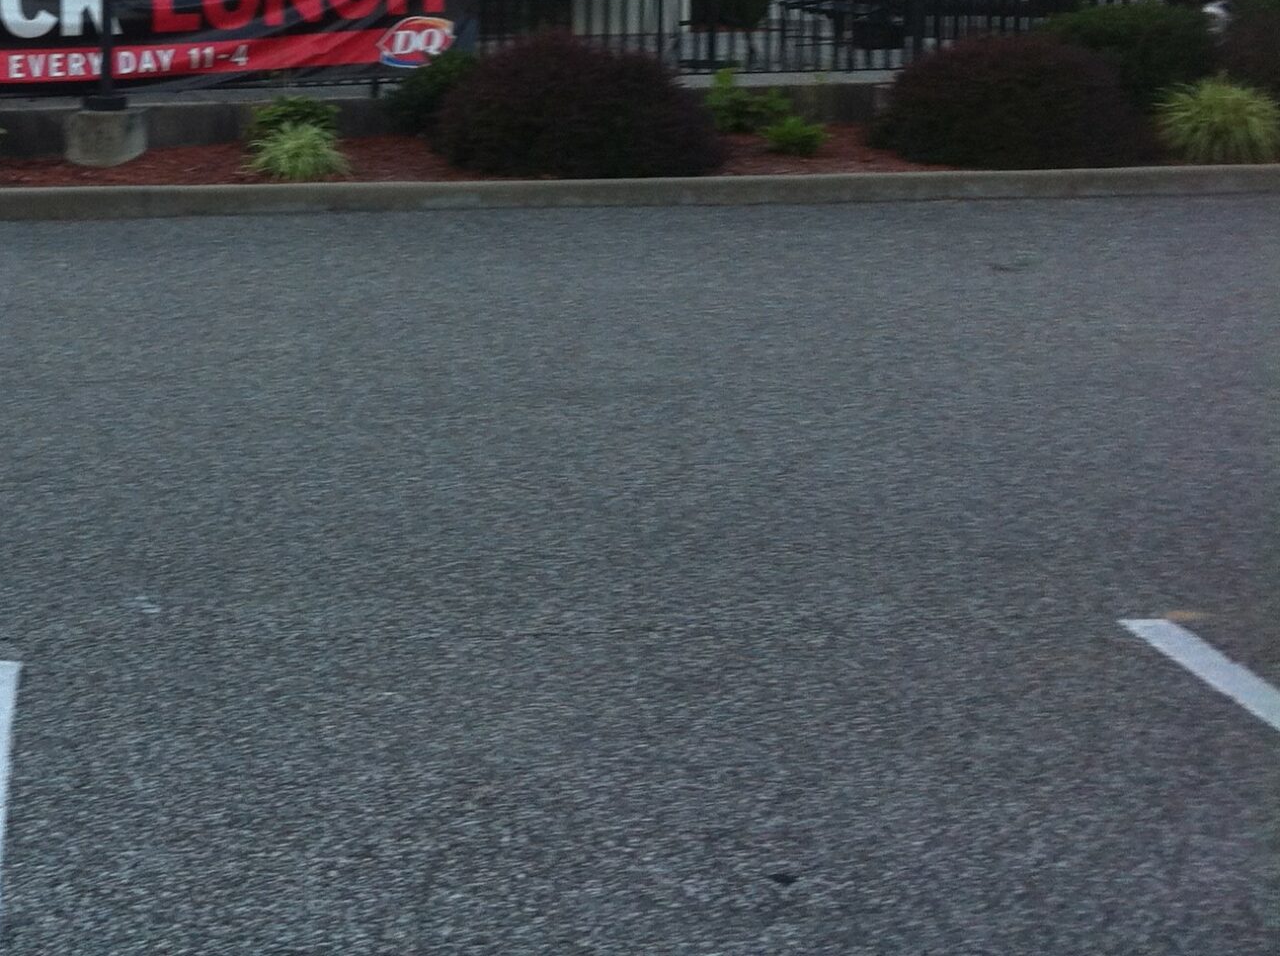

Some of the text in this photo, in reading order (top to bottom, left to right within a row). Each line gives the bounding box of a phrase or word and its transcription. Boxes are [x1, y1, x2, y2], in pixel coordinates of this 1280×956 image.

[392, 28, 443, 56] DQ
[7, 44, 248, 79] EVERY DAY 11-4
